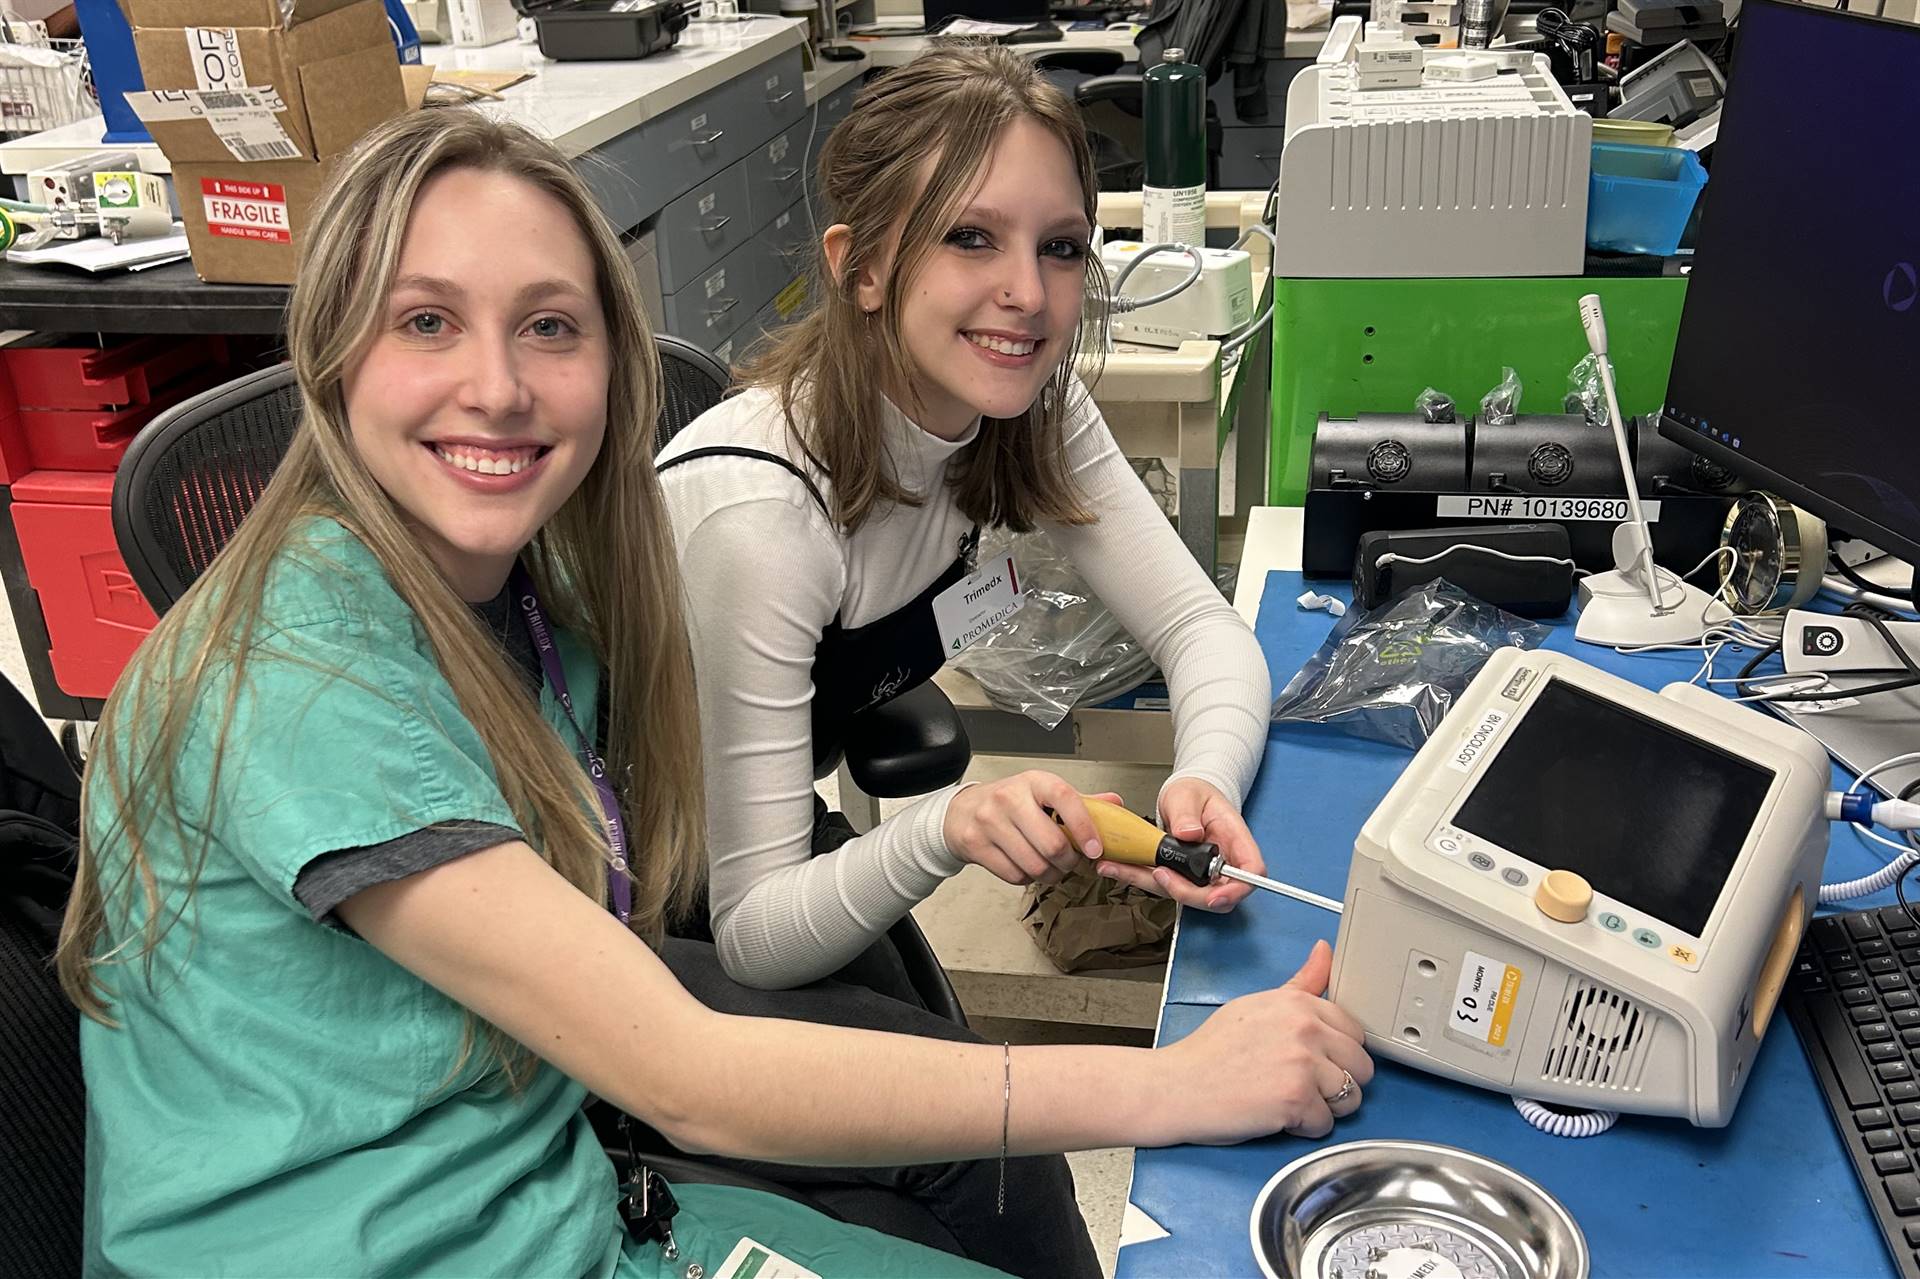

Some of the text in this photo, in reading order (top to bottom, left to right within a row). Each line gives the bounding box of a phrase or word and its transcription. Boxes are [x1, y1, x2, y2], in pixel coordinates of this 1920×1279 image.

[212, 201, 282, 224] FRAGILE
[220, 226, 279, 240] HANDLE WITH CARE
[1467, 498, 1629, 519] PN# 10139680
[963, 575, 1002, 605] Trimedx
[528, 609, 553, 652] TRIMEDX
[962, 602, 1018, 643] PROMEDICA
[1456, 724, 1497, 767] ONCOLOGY
[1457, 965, 1485, 1023] MONTH: 03
